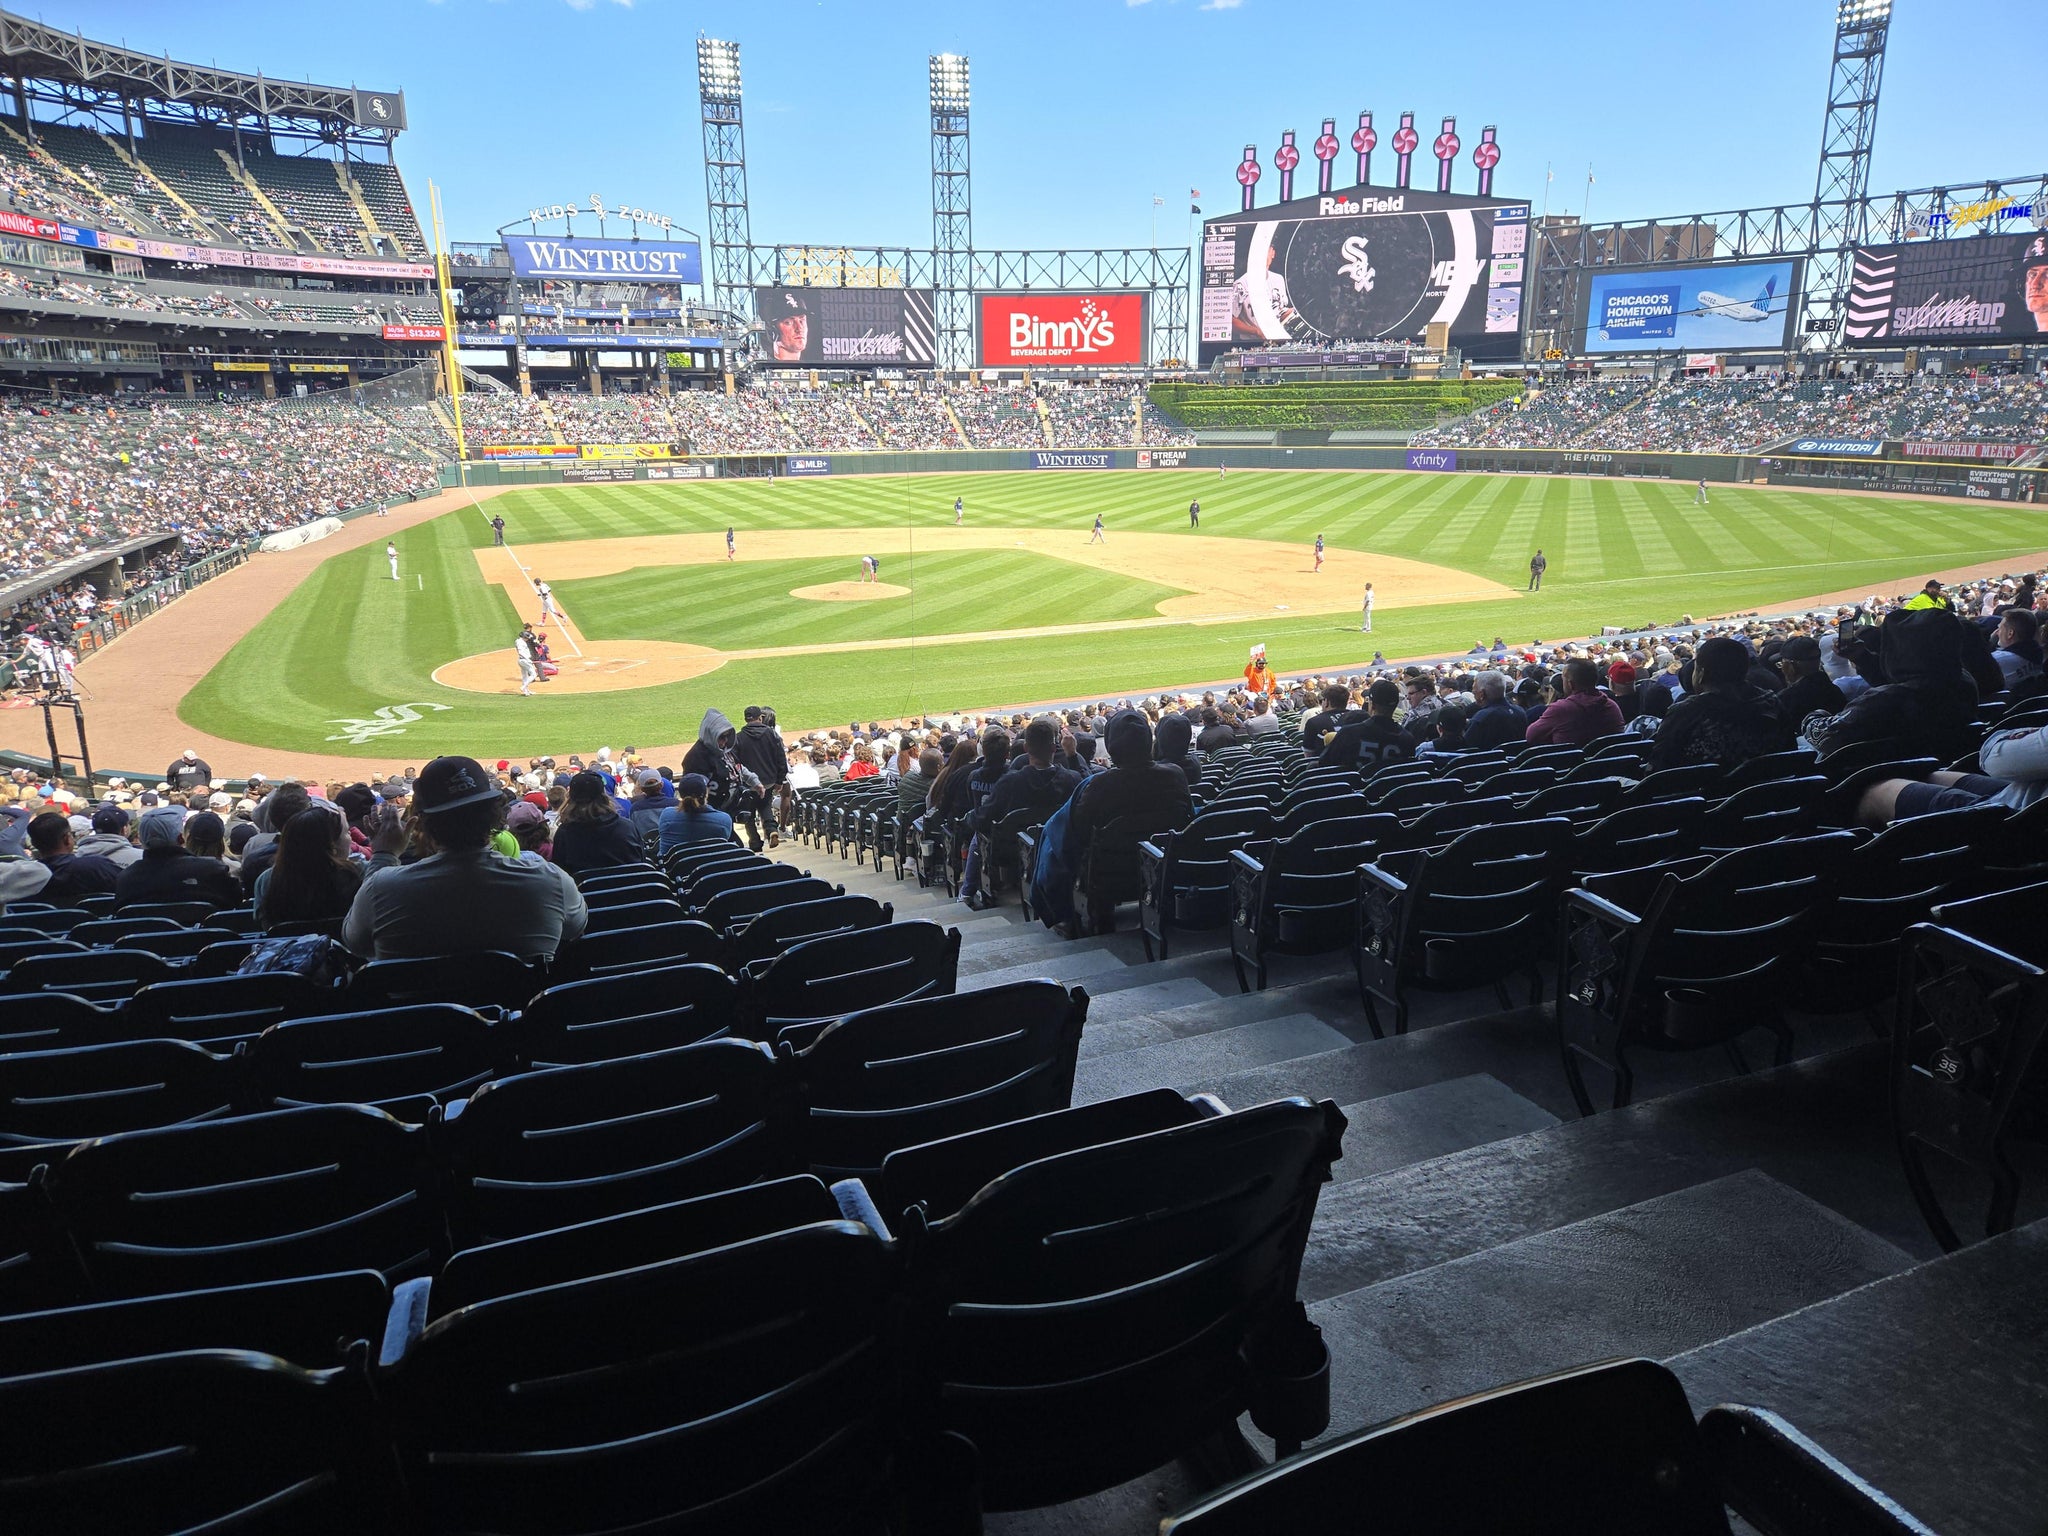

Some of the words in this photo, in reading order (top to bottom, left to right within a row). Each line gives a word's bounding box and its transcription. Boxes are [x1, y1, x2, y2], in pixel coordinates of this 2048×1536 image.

[1320, 197, 1360, 215] Rate
[1362, 196, 1404, 213] Field
[529, 203, 578, 224] KIDS
[618, 205, 672, 230] ZONE
[1947, 196, 2017, 230] Miller
[2000, 205, 2032, 220] TIME
[785, 248, 854, 262] CAESARS
[1900, 256, 2013, 282] SHORTSTOP
[787, 266, 902, 287] SPORTSBOOK
[1608, 294, 1669, 306] CHICAGO'S
[820, 304, 899, 321] SHORTSTOP
[1606, 306, 1672, 318] HOMETOWN
[1893, 302, 2006, 329] SHORTSTOP
[1606, 318, 1646, 328] AIRLINE
[1814, 320, 1835, 330] 2:19
[409, 328, 441, 338] $13,324
[822, 338, 900, 355] SHORTSTOP
[876, 369, 903, 380] Modelo
[1818, 442, 1874, 453] HYUNDAI
[1906, 443, 1978, 456] WHITTINGHAM
[1980, 444, 2016, 458] MEATS
[1036, 452, 1108, 466] WINTRUST
[1152, 452, 1186, 460] STREAM
[1412, 452, 1448, 468] xfinity
[1564, 453, 1582, 461] THE
[1583, 454, 1612, 462] PATIO
[648, 468, 668, 478] Rate
[1970, 470, 2016, 478] EVERYTHING
[1966, 485, 1990, 498] Rate
[1939, 1058, 1958, 1074] 35
